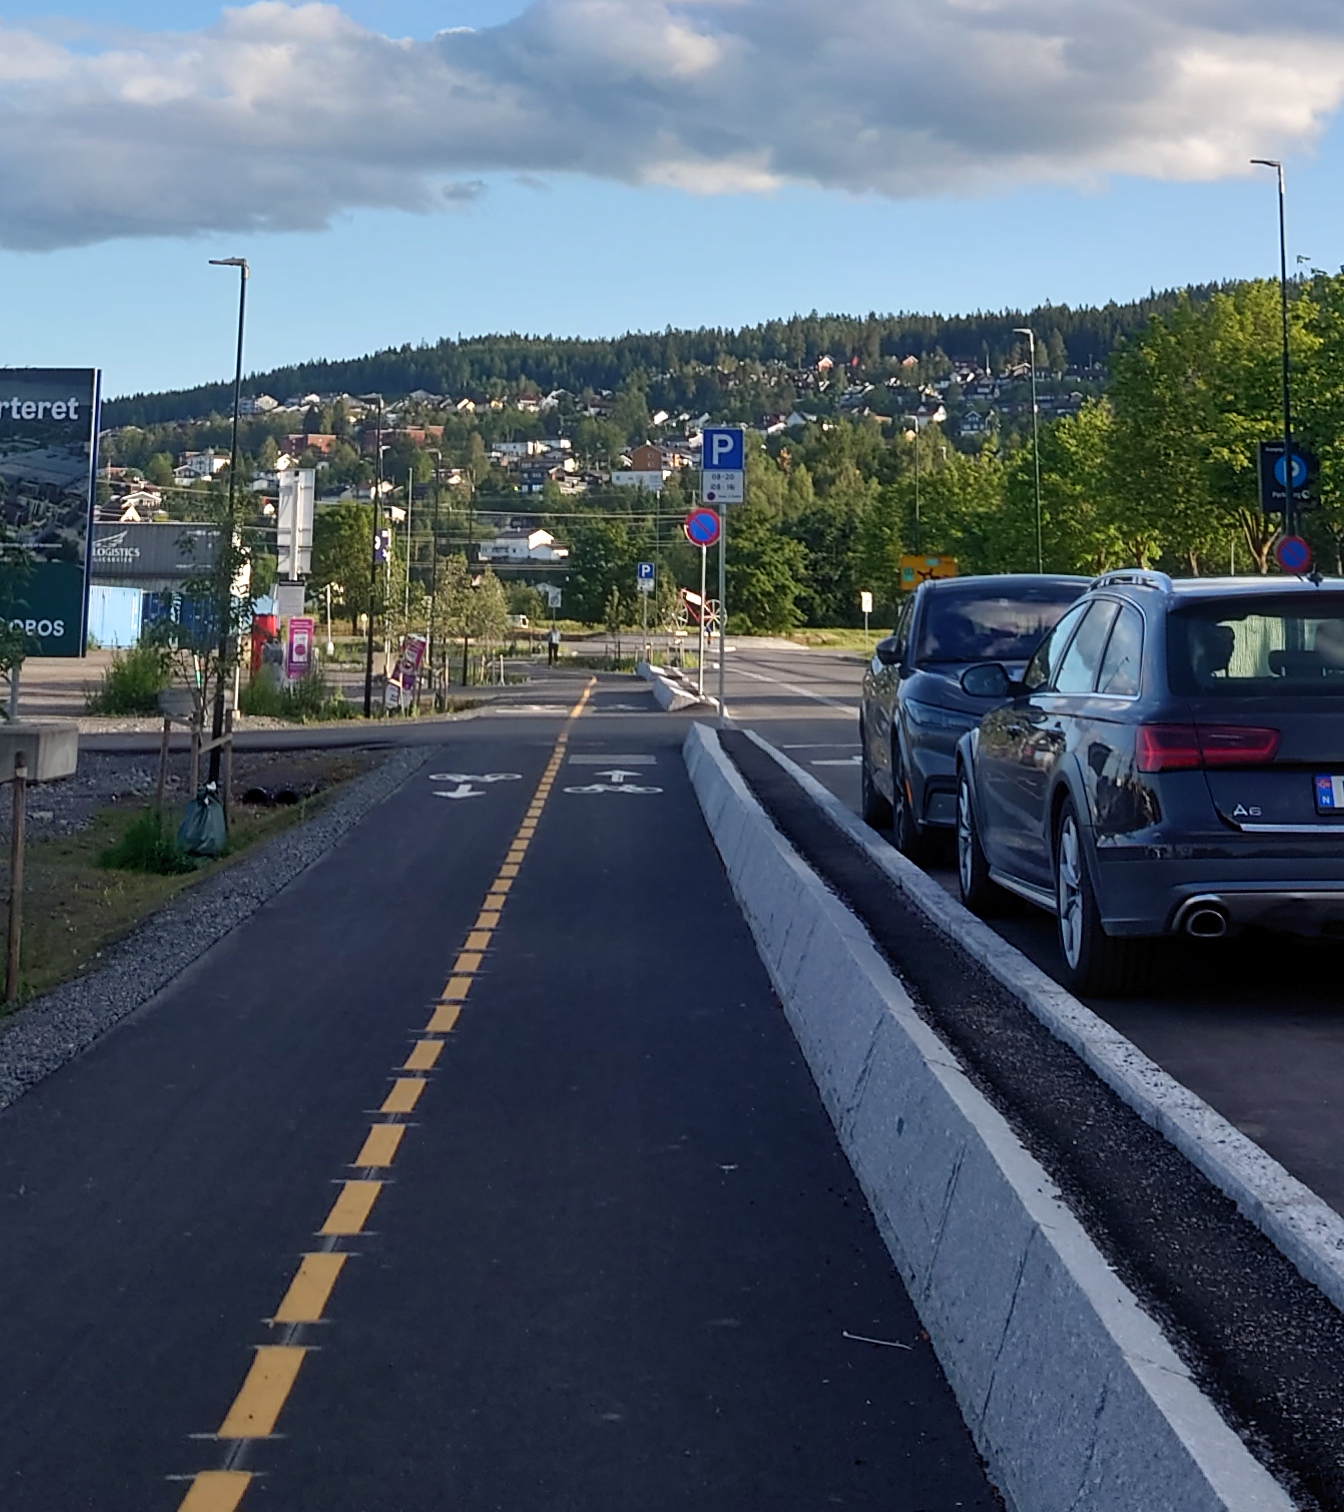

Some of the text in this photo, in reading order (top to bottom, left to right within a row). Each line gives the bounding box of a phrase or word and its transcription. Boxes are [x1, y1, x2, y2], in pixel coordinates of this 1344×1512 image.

[712, 433, 734, 465] P
[92, 547, 141, 557] LOGISTICS
[641, 564, 651, 577] P
[1322, 795, 1330, 804] N
[1233, 803, 1262, 816] A6
